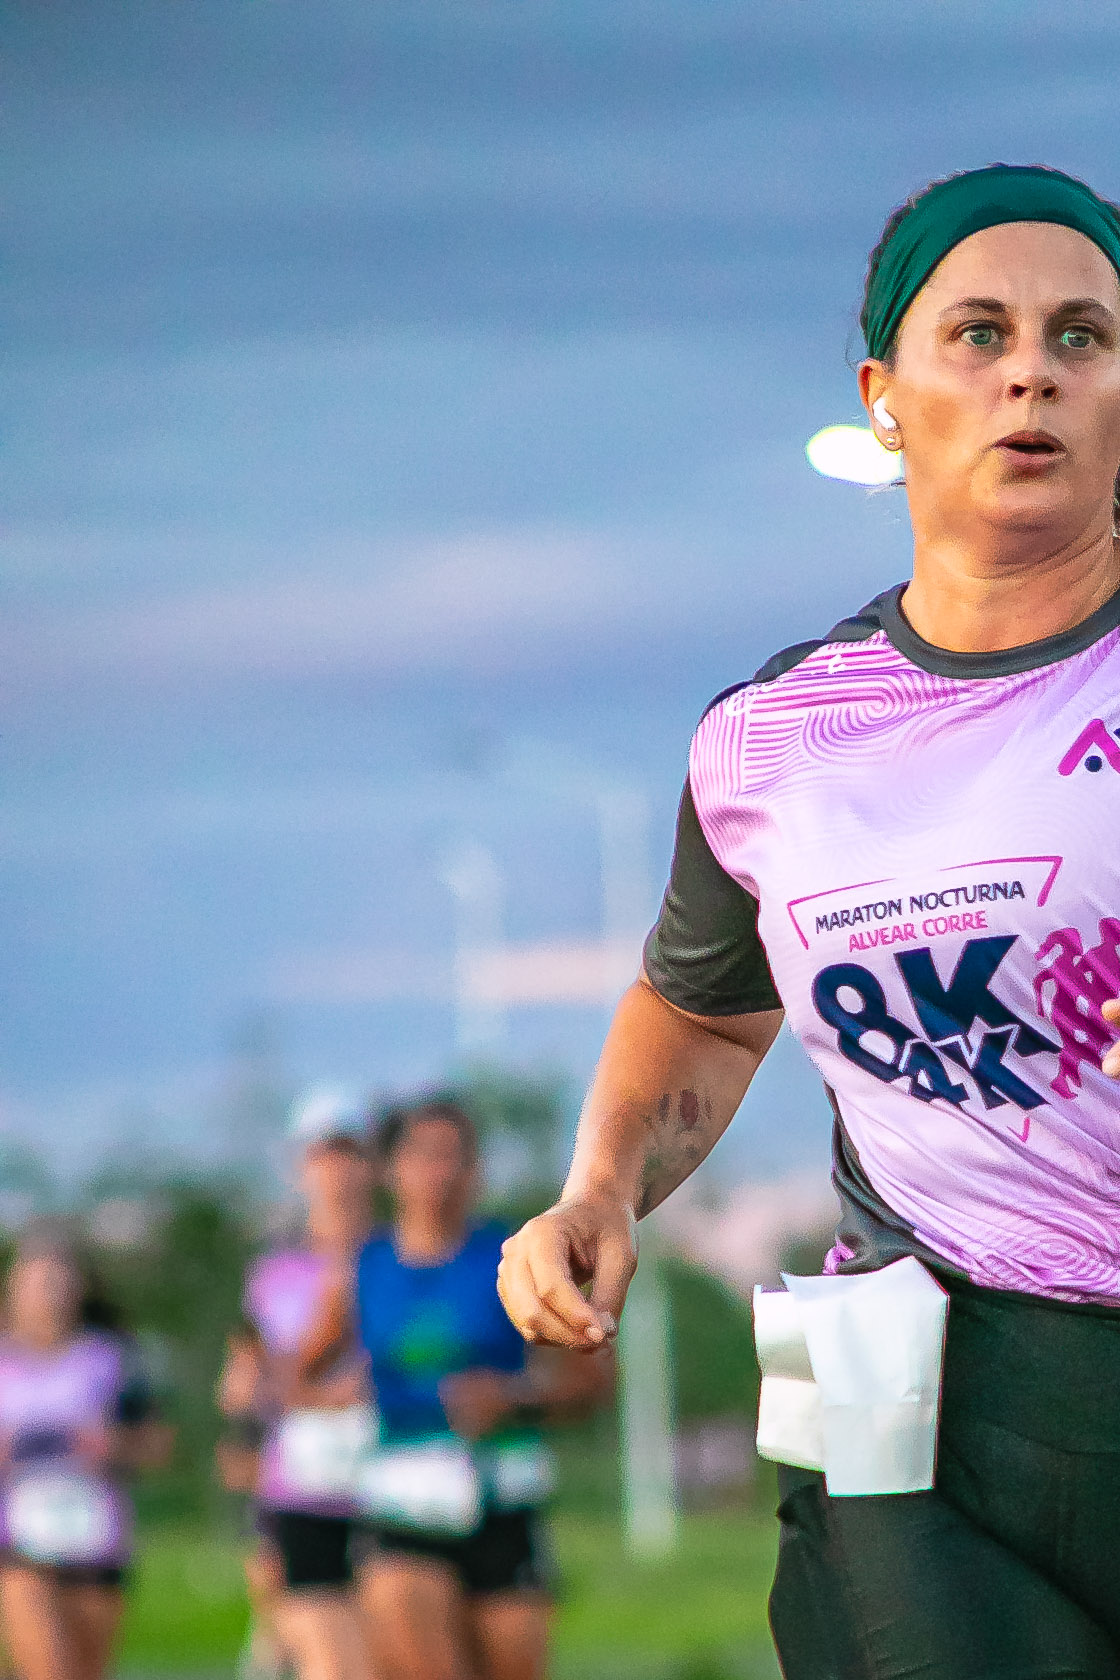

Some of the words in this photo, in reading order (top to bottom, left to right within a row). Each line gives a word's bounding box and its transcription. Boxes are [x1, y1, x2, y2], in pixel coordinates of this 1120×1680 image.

[815, 899, 901, 934] MARATON
[909, 881, 1025, 913] NOCTURNA
[849, 923, 917, 952] ALVEAR
[922, 910, 988, 936] CORRE
[811, 935, 1063, 1083] 8K
